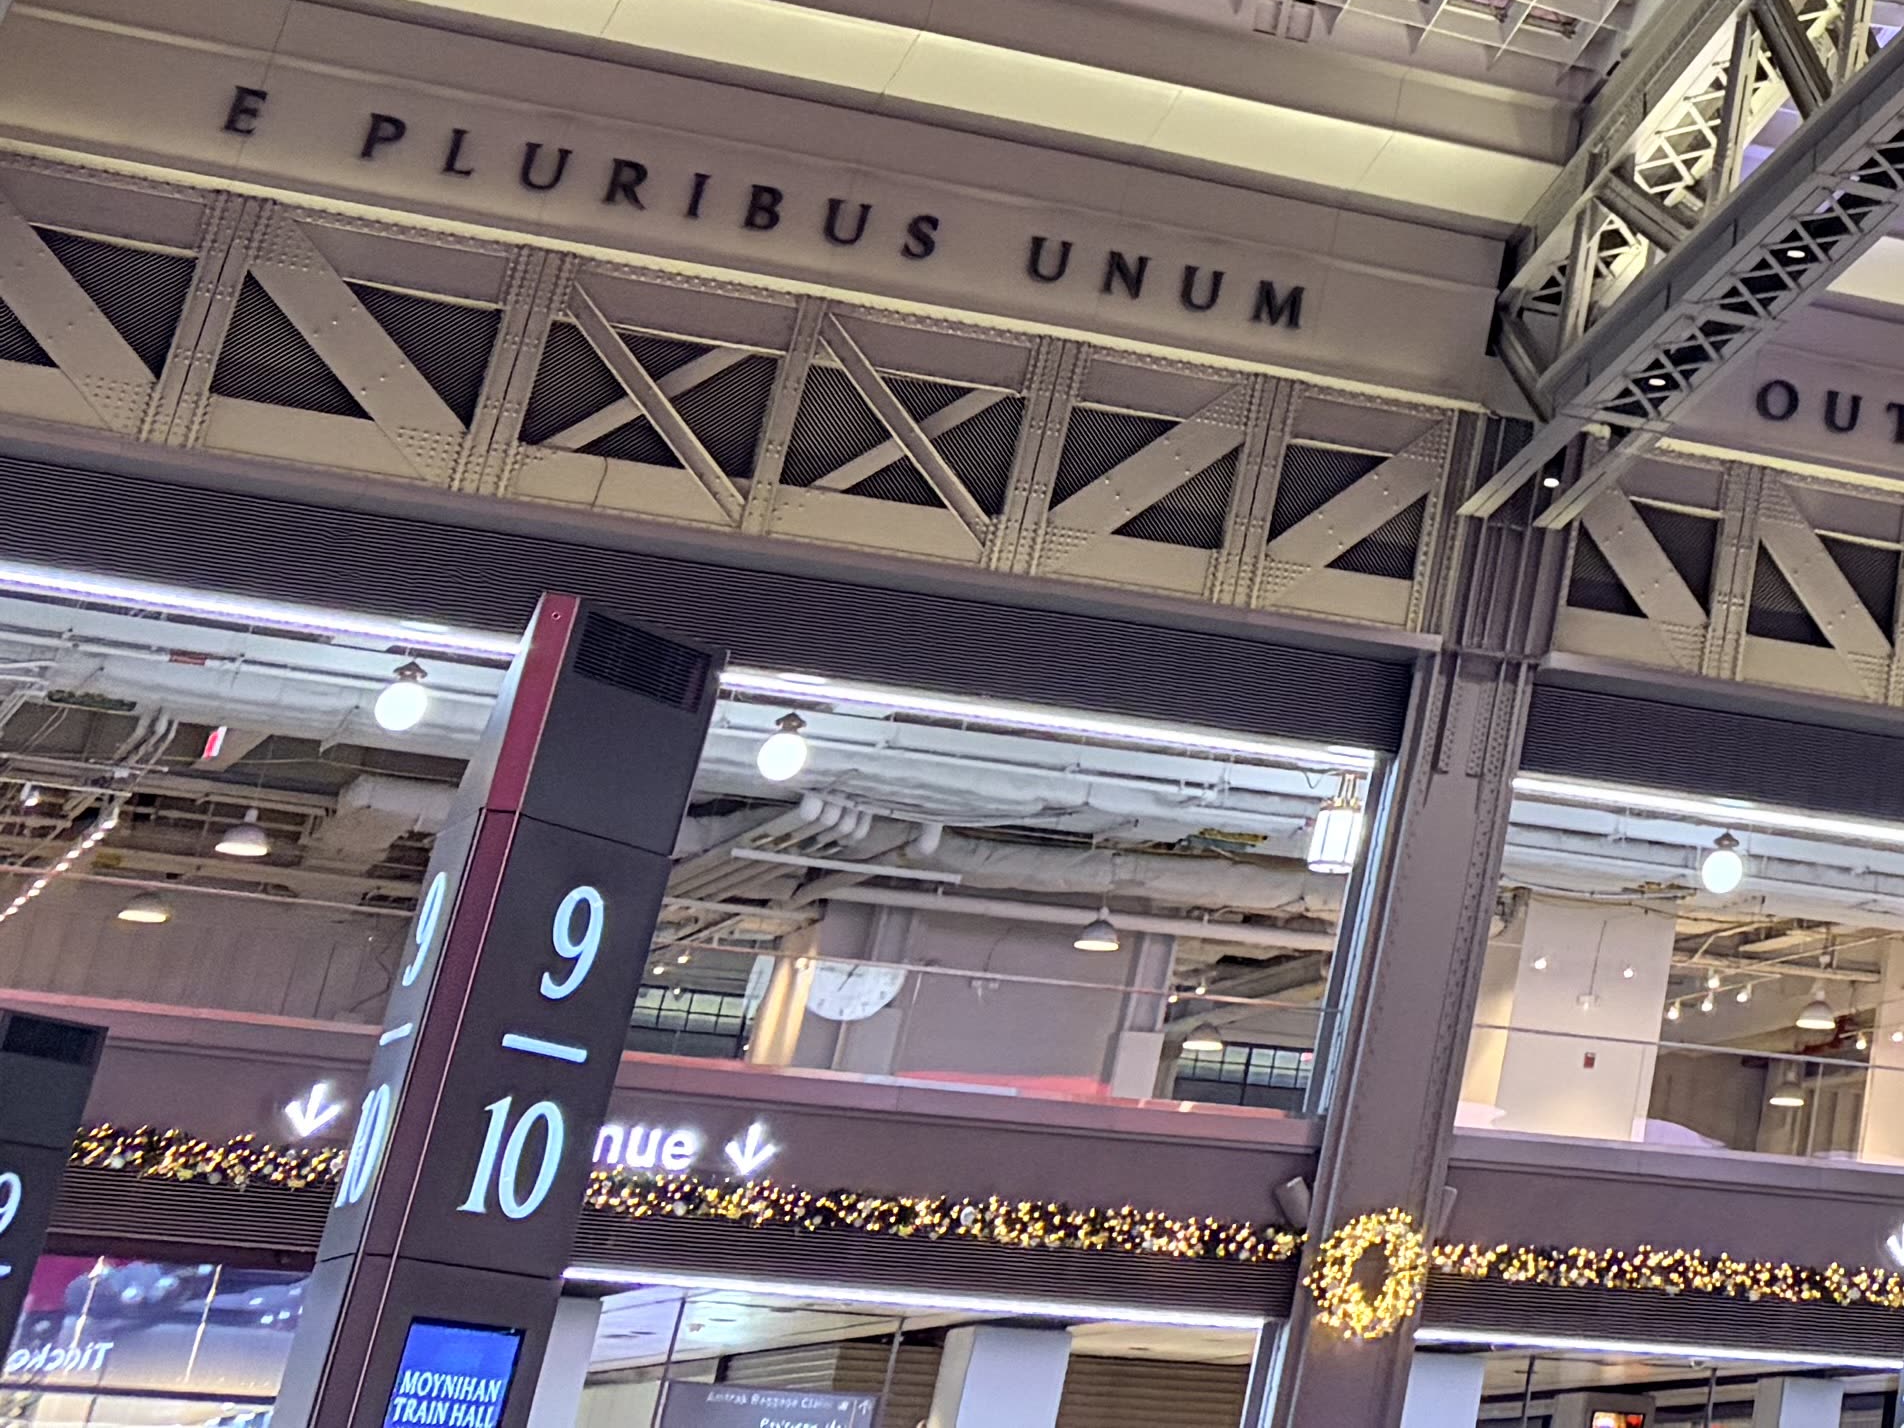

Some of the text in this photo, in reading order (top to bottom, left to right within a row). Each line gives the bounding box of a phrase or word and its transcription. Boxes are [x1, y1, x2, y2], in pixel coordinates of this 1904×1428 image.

[221, 84, 1306, 330] E PLURIBUS UNUM
[401, 871, 447, 987] 9
[539, 886, 604, 1001] 9
[335, 1083, 390, 1209] 10
[456, 1095, 565, 1220] 10
[592, 1122, 700, 1171] nue
[393, 1396, 495, 1428] TRAIN HALL
[399, 1369, 502, 1403] MOYNIHAN
